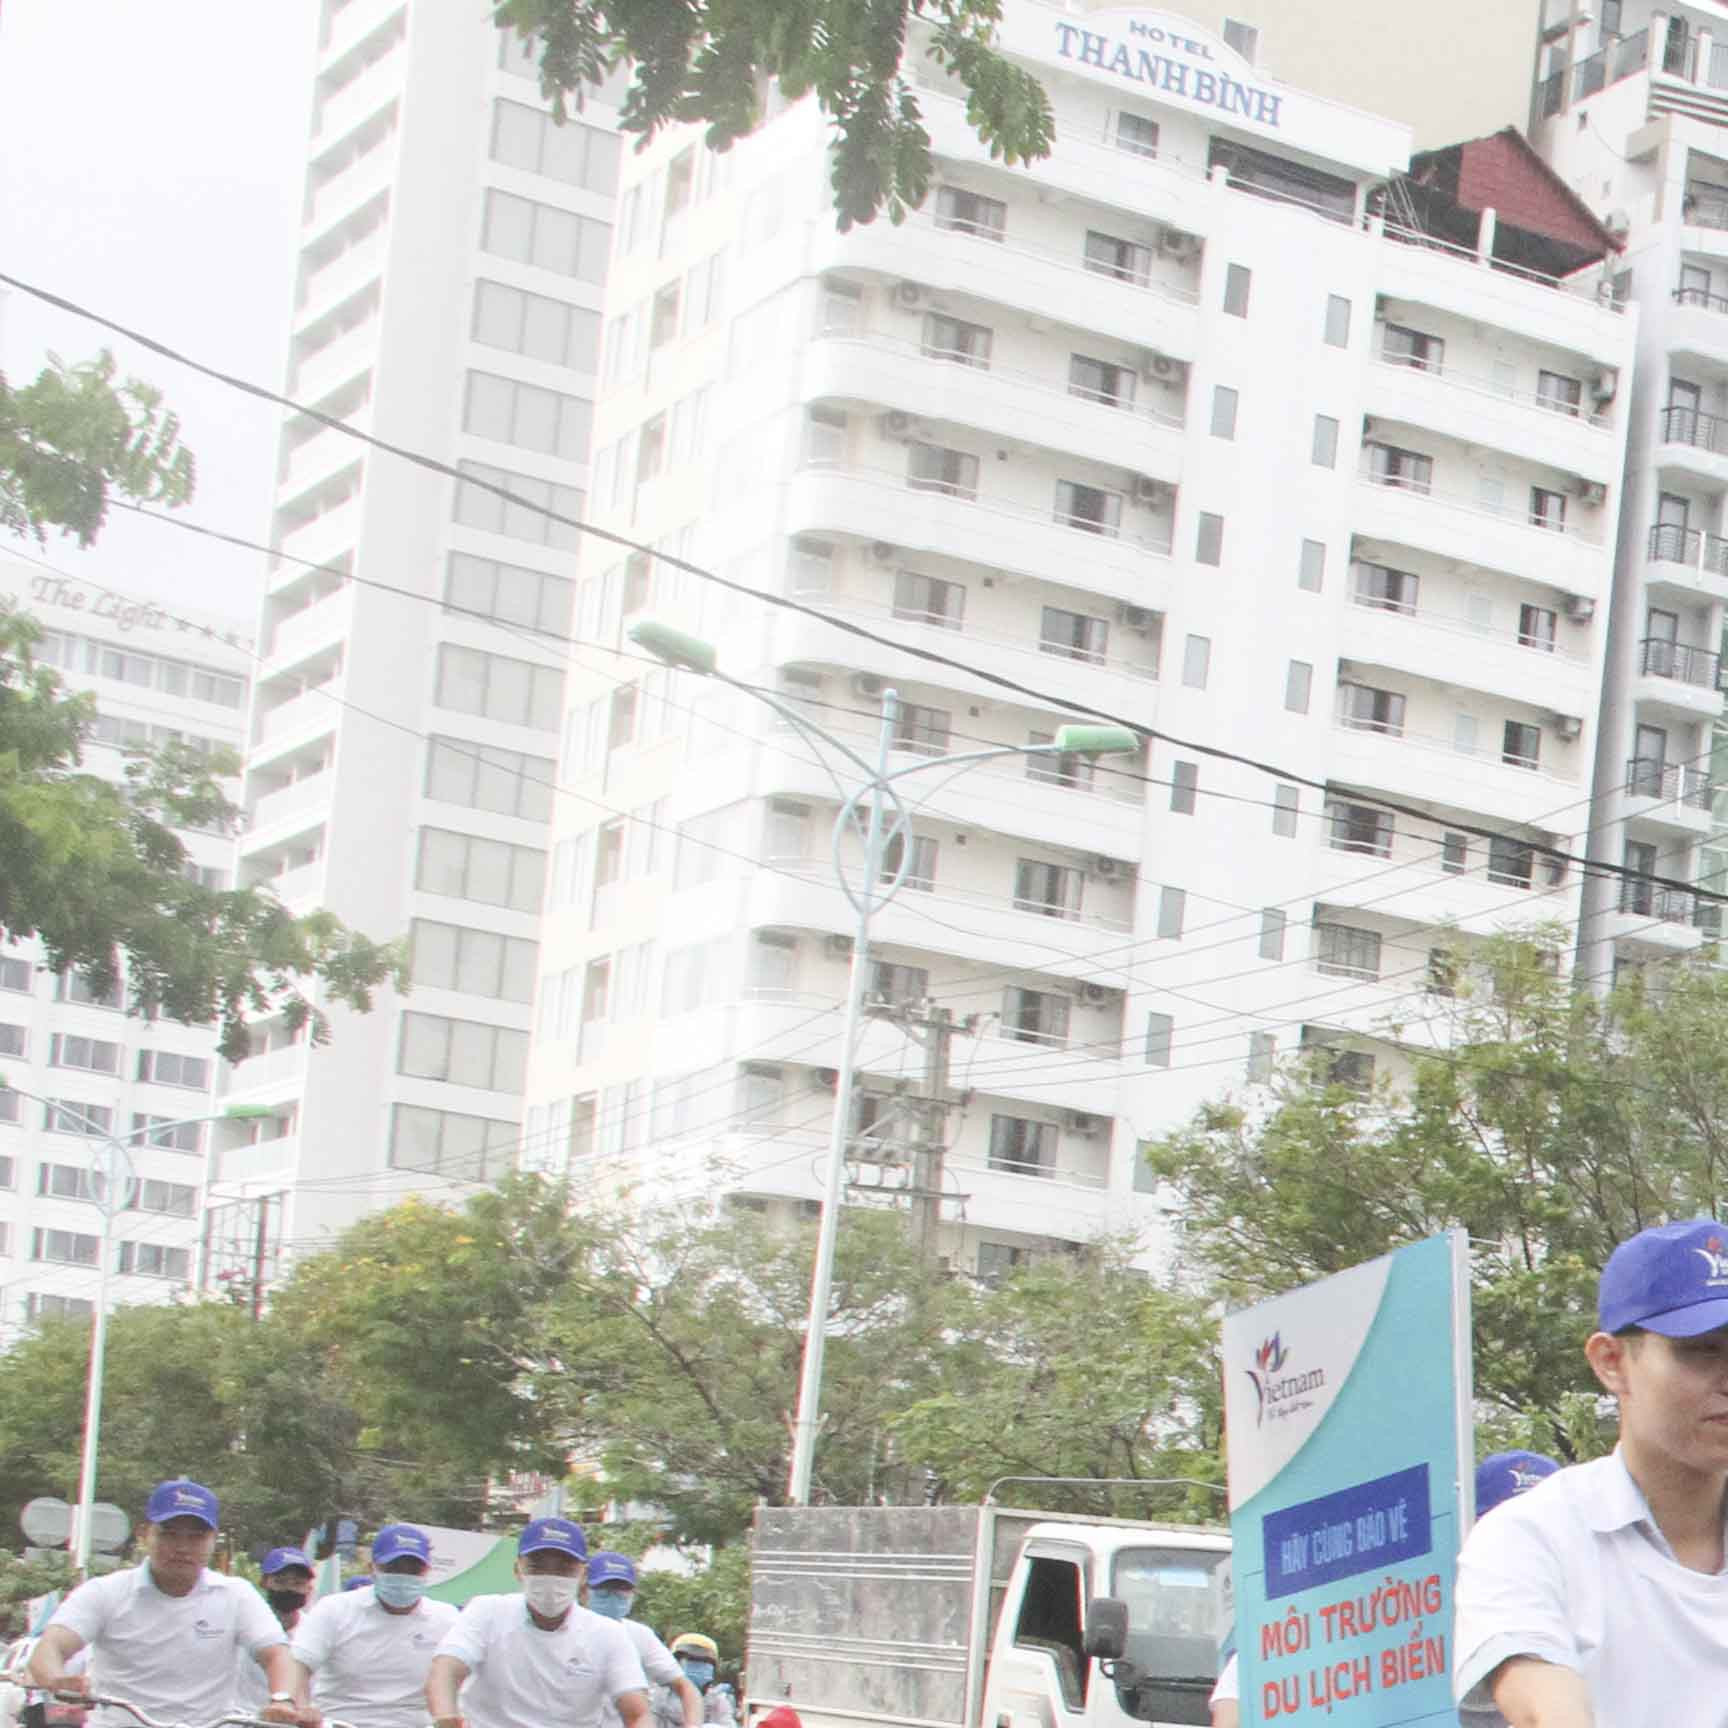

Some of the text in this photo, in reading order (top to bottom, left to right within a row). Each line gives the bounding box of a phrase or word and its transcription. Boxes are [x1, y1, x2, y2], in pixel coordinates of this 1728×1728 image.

[1056, 21, 1284, 126] THANH BÌNH
[1129, 19, 1215, 61] HOTEL
[31, 575, 168, 632] The Light
[1243, 1369, 1326, 1429] Vietnam
[1261, 1573, 1442, 1662] MÔI TRƯỜNG
[1263, 1620, 1445, 1721] DU LỊCH BIỂN
